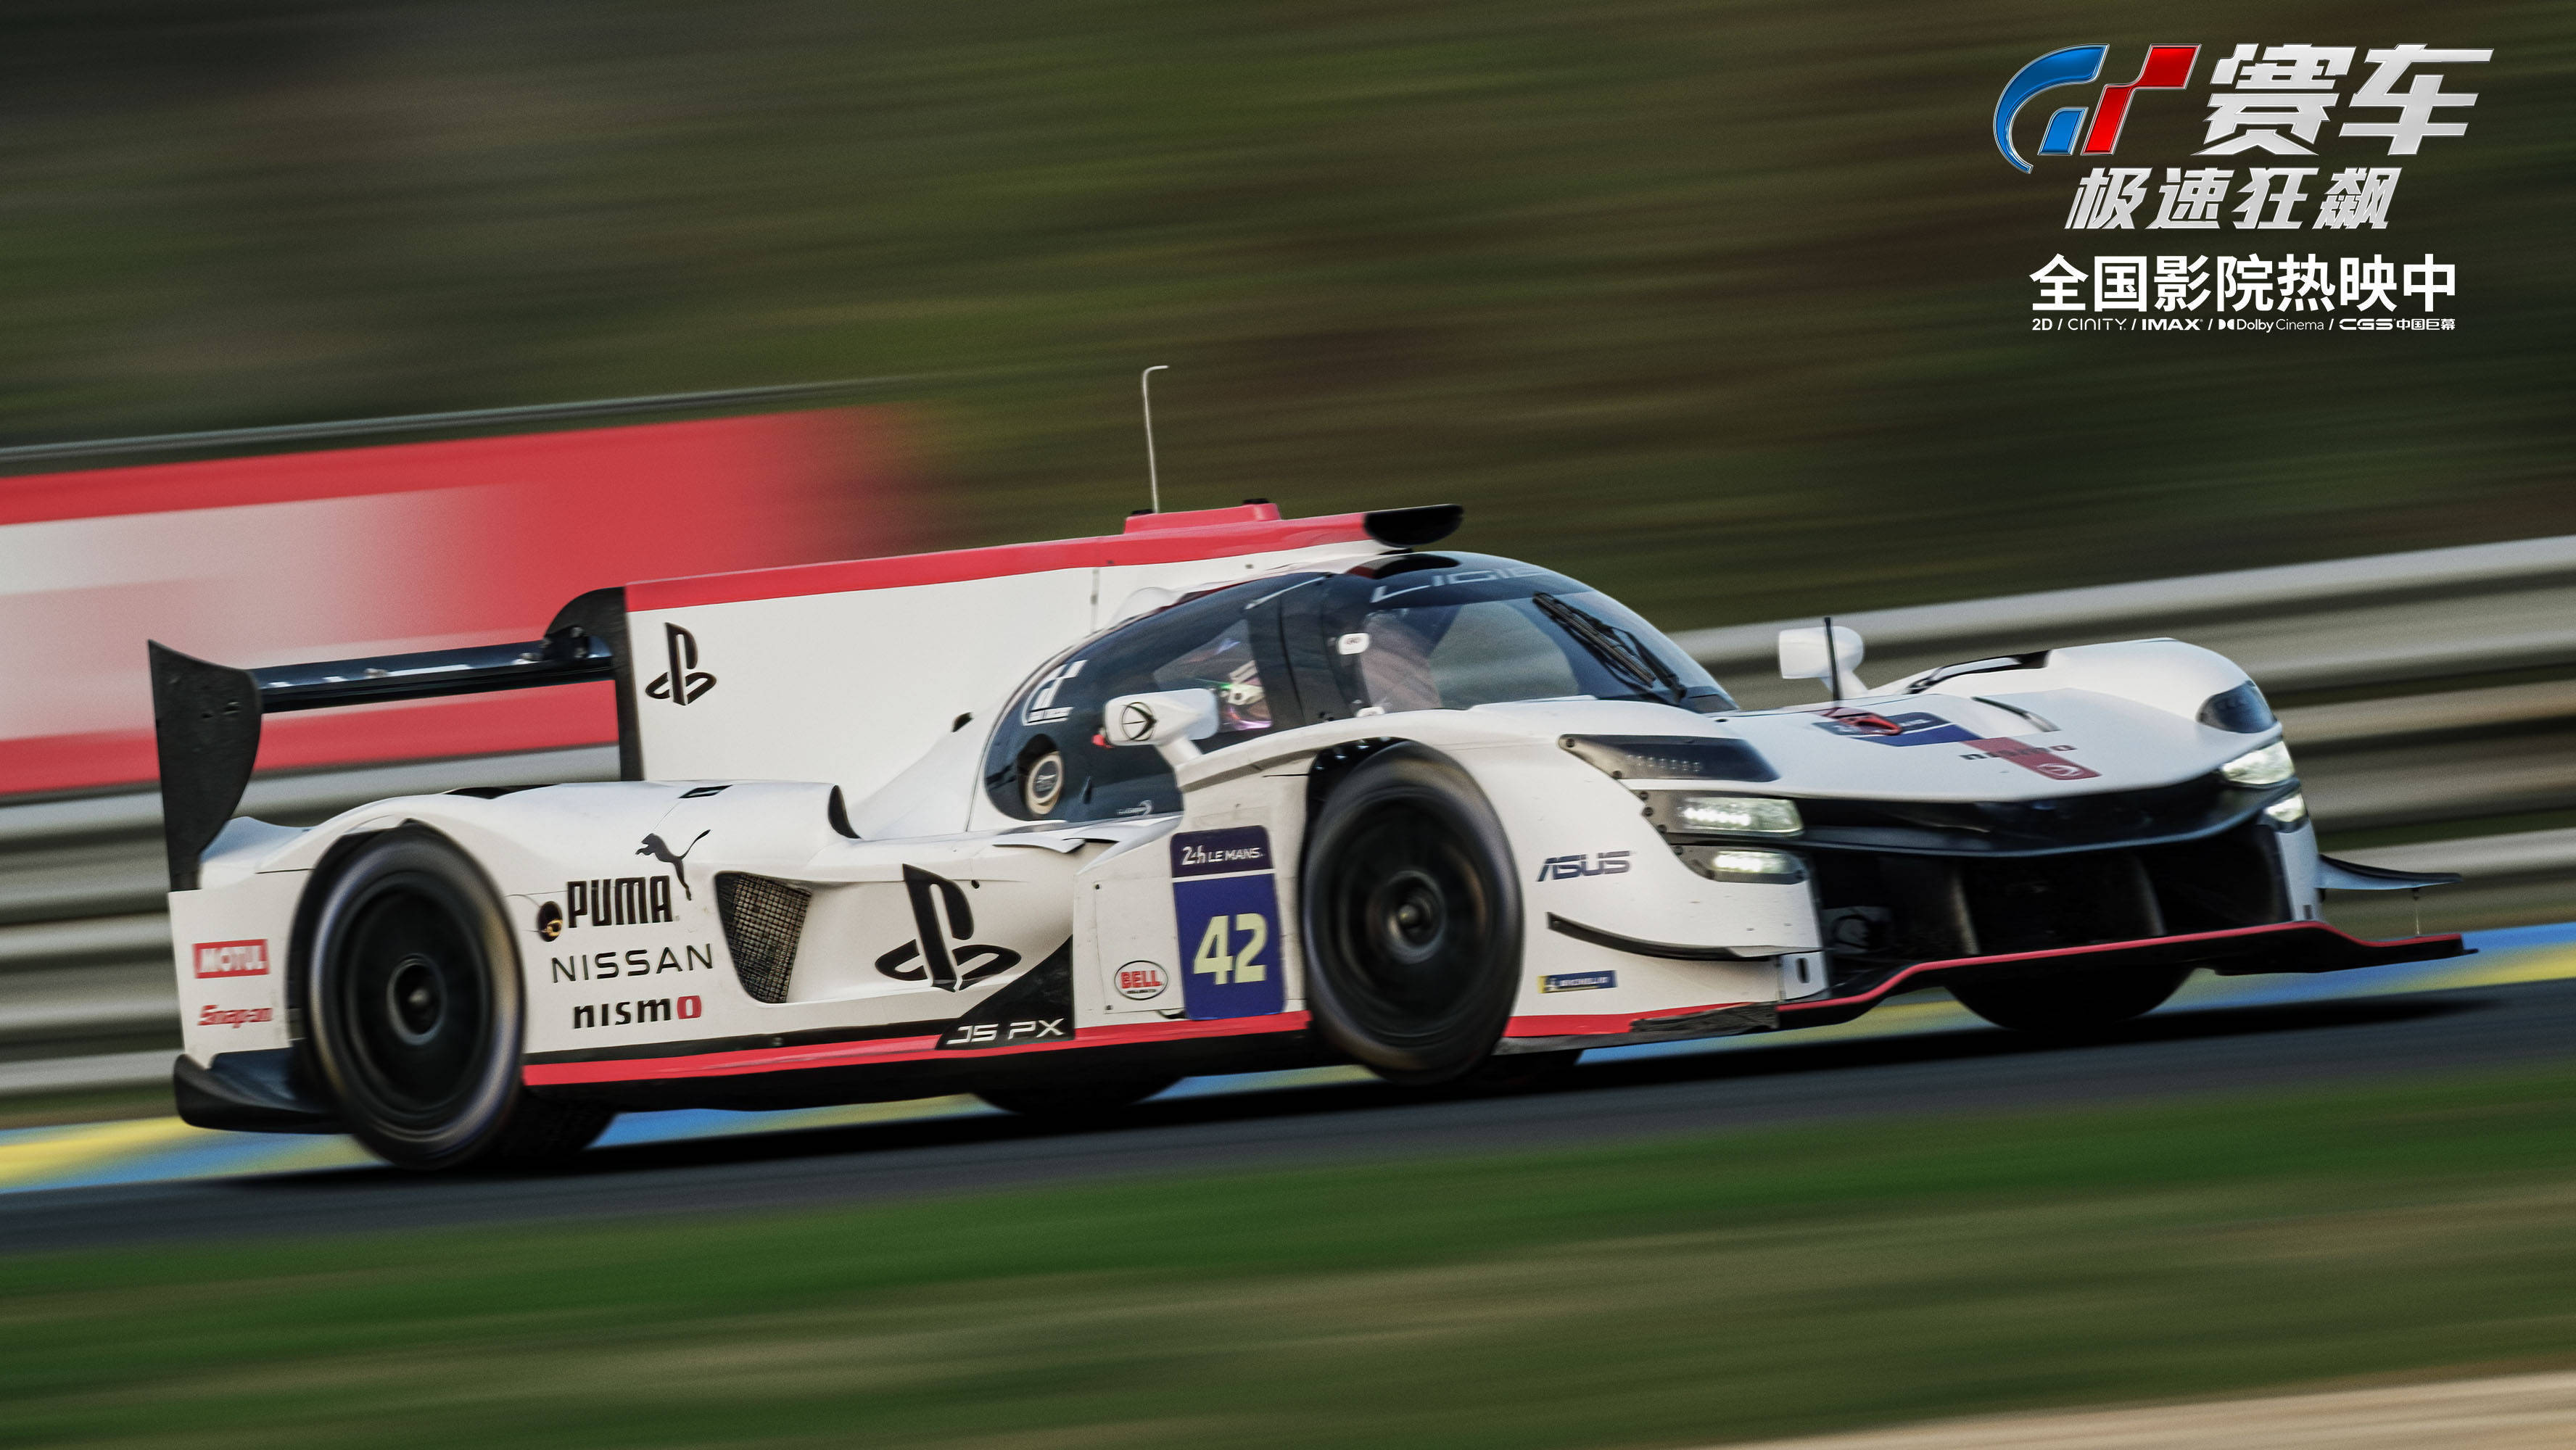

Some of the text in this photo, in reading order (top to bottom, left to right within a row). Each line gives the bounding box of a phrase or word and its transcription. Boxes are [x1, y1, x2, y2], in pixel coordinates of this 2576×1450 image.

[1208, 850, 1224, 863] LE
[1536, 850, 1631, 882] ASUS
[566, 875, 674, 929] PUMA
[551, 942, 714, 984] NISSAN
[1193, 913, 1268, 985] 42
[1120, 970, 1163, 989] BELL
[573, 995, 702, 1030] nismo
[946, 1017, 1065, 1045] JS PX
